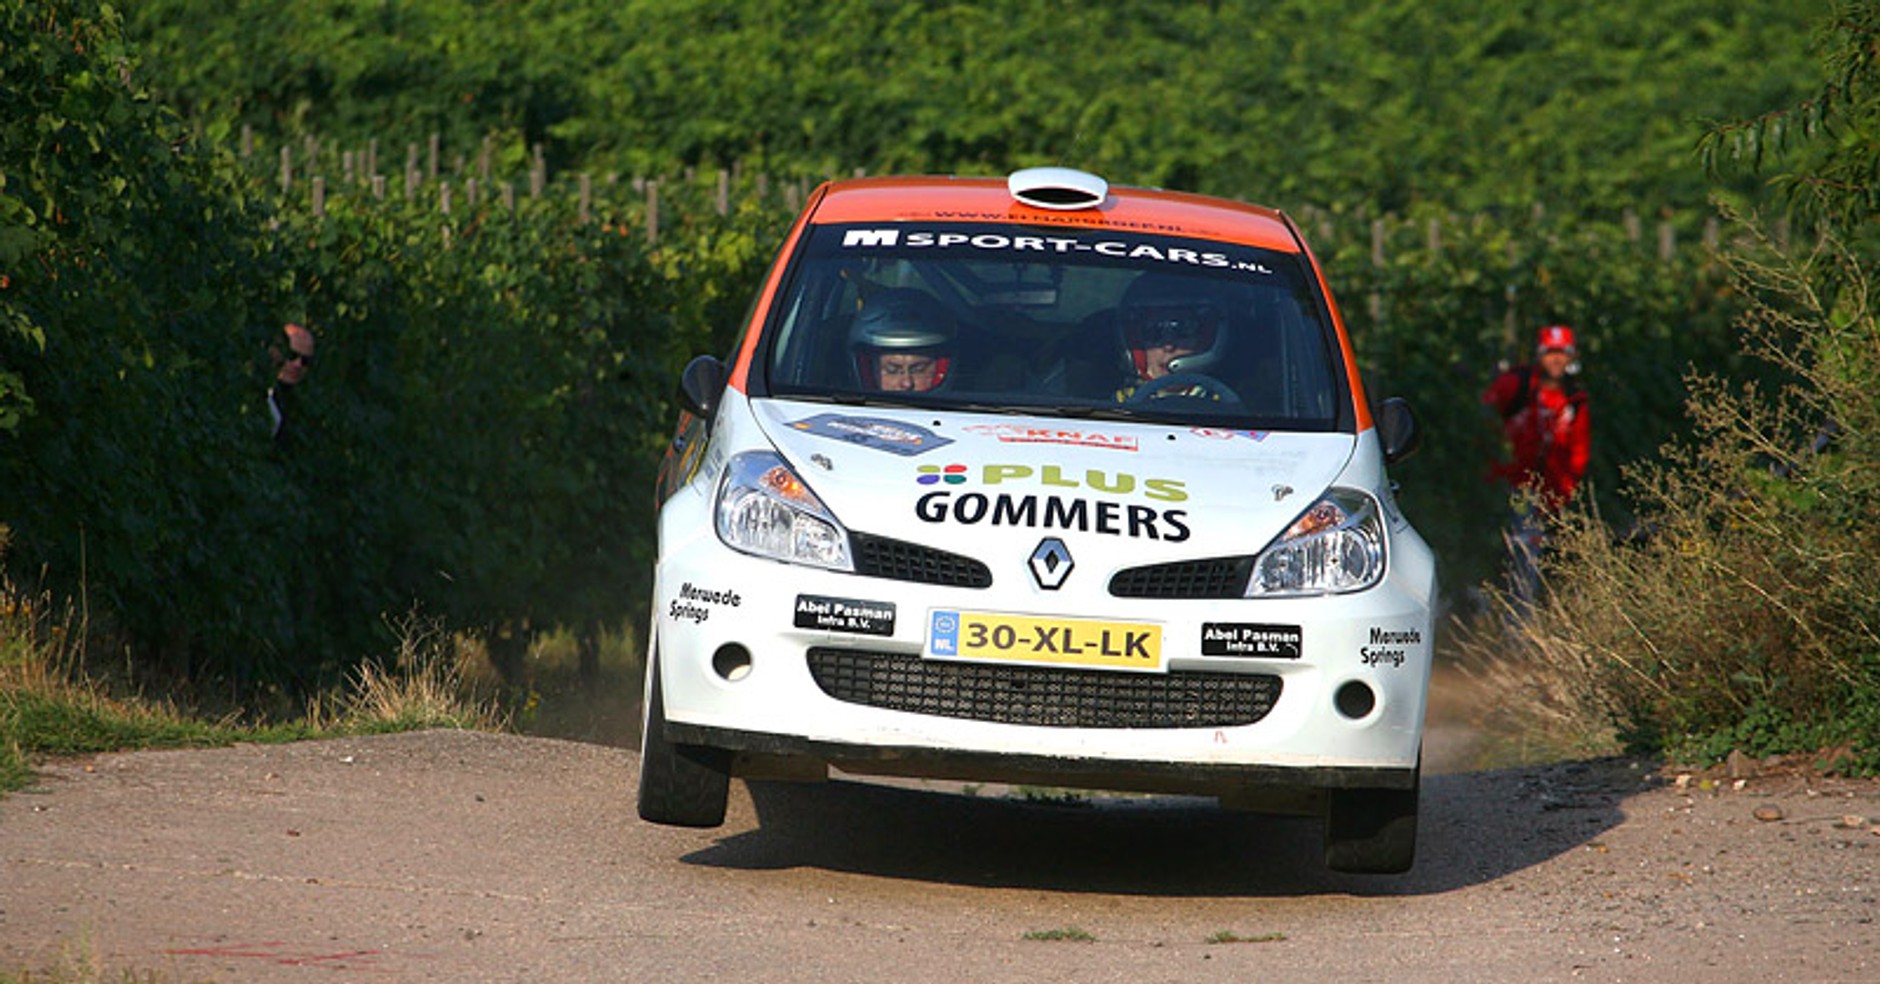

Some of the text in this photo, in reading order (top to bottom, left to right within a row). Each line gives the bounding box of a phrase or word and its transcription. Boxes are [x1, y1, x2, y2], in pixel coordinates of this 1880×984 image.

[842, 230, 899, 246] M
[1027, 428, 1132, 443] KNAF
[982, 465, 1188, 502] PLUS
[916, 491, 1191, 543] GOMMERS
[680, 582, 741, 607] Merwede
[669, 599, 708, 624] Springs
[797, 601, 892, 620] Abel Pasman
[818, 615, 871, 628] Infra B.V.
[934, 639, 953, 650] NL
[965, 622, 1151, 659] 30-XL-LK
[1204, 628, 1299, 643] Abel Pasman
[1226, 641, 1280, 653] Infra B.V.
[1360, 646, 1405, 668] Springs
